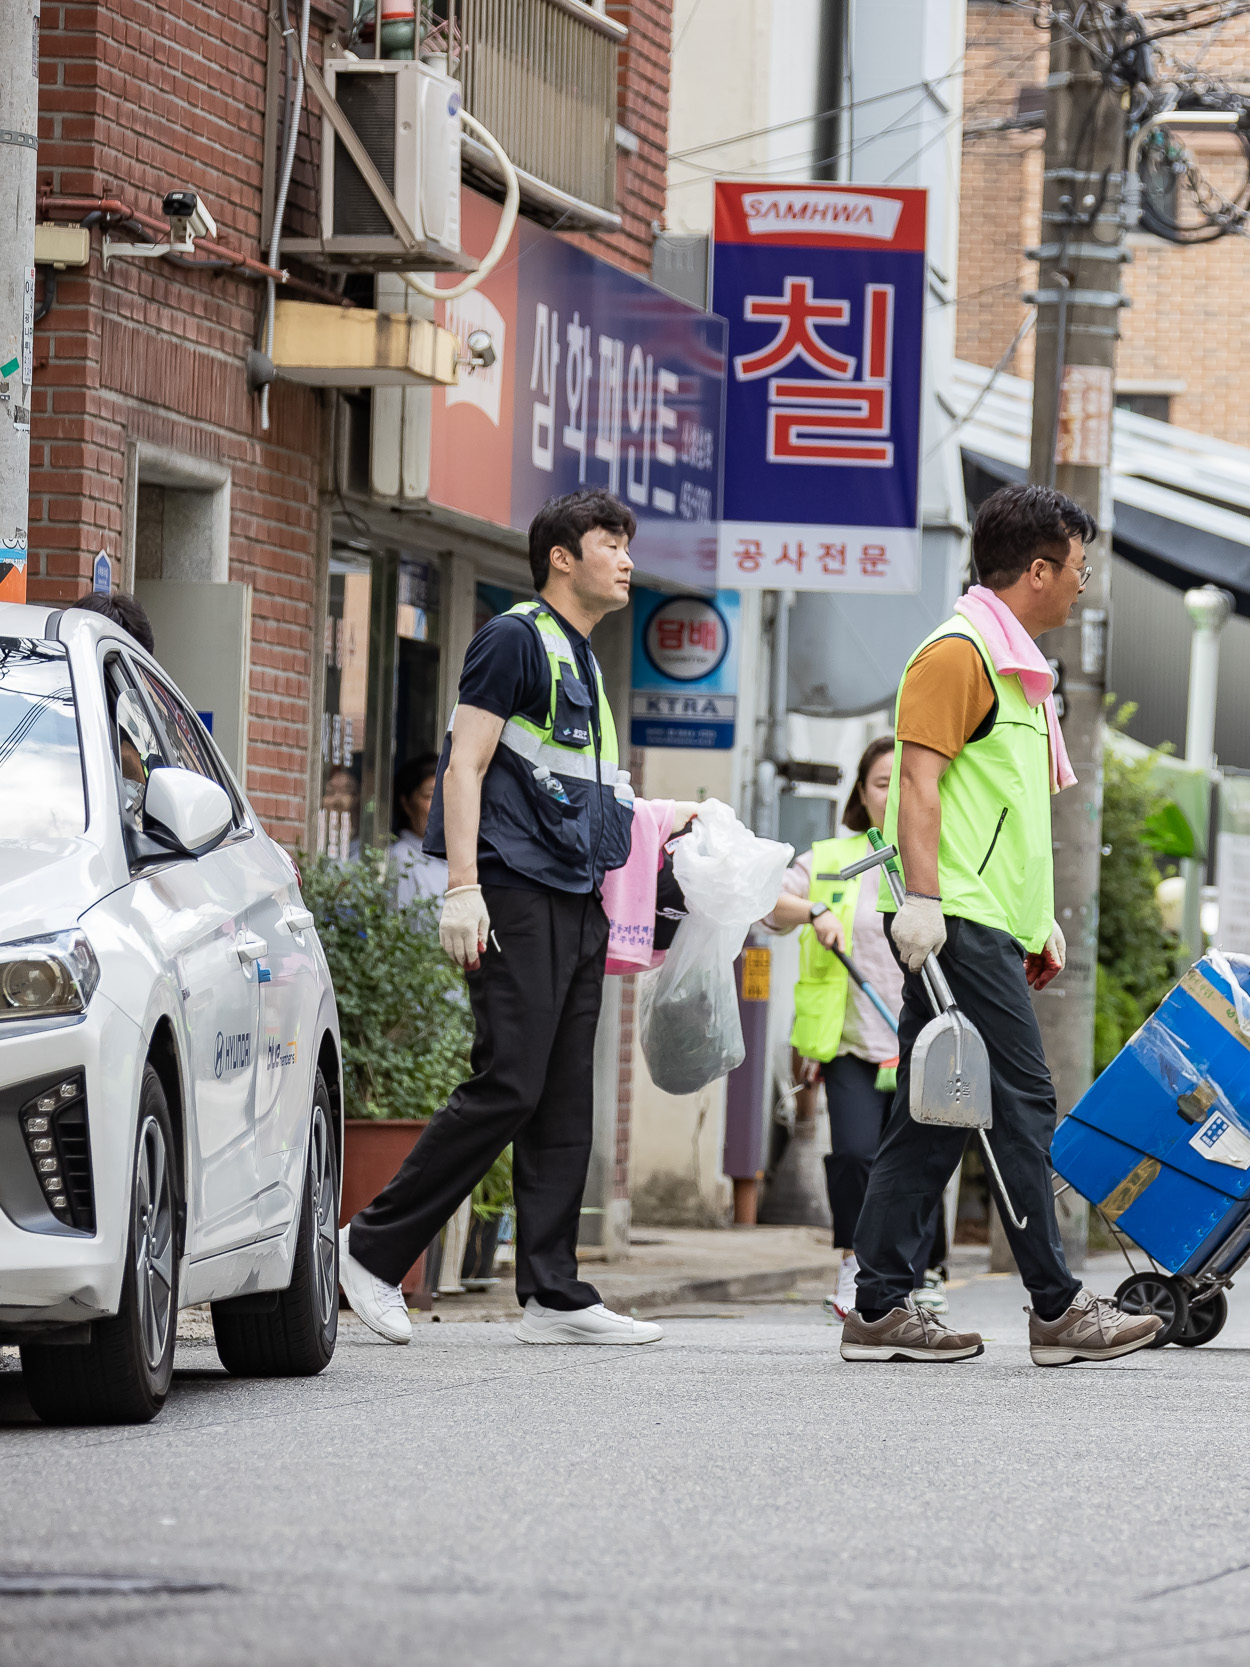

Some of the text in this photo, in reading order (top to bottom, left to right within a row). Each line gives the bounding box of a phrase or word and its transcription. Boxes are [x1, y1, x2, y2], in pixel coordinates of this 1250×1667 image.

[748, 199, 873, 224] SAMHWA
[734, 275, 895, 468] 칠
[529, 301, 679, 515] 삼화페인트
[733, 538, 889, 577] 공사전문
[657, 619, 717, 652] 담배
[225, 1032, 252, 1071] HYUNDAI
